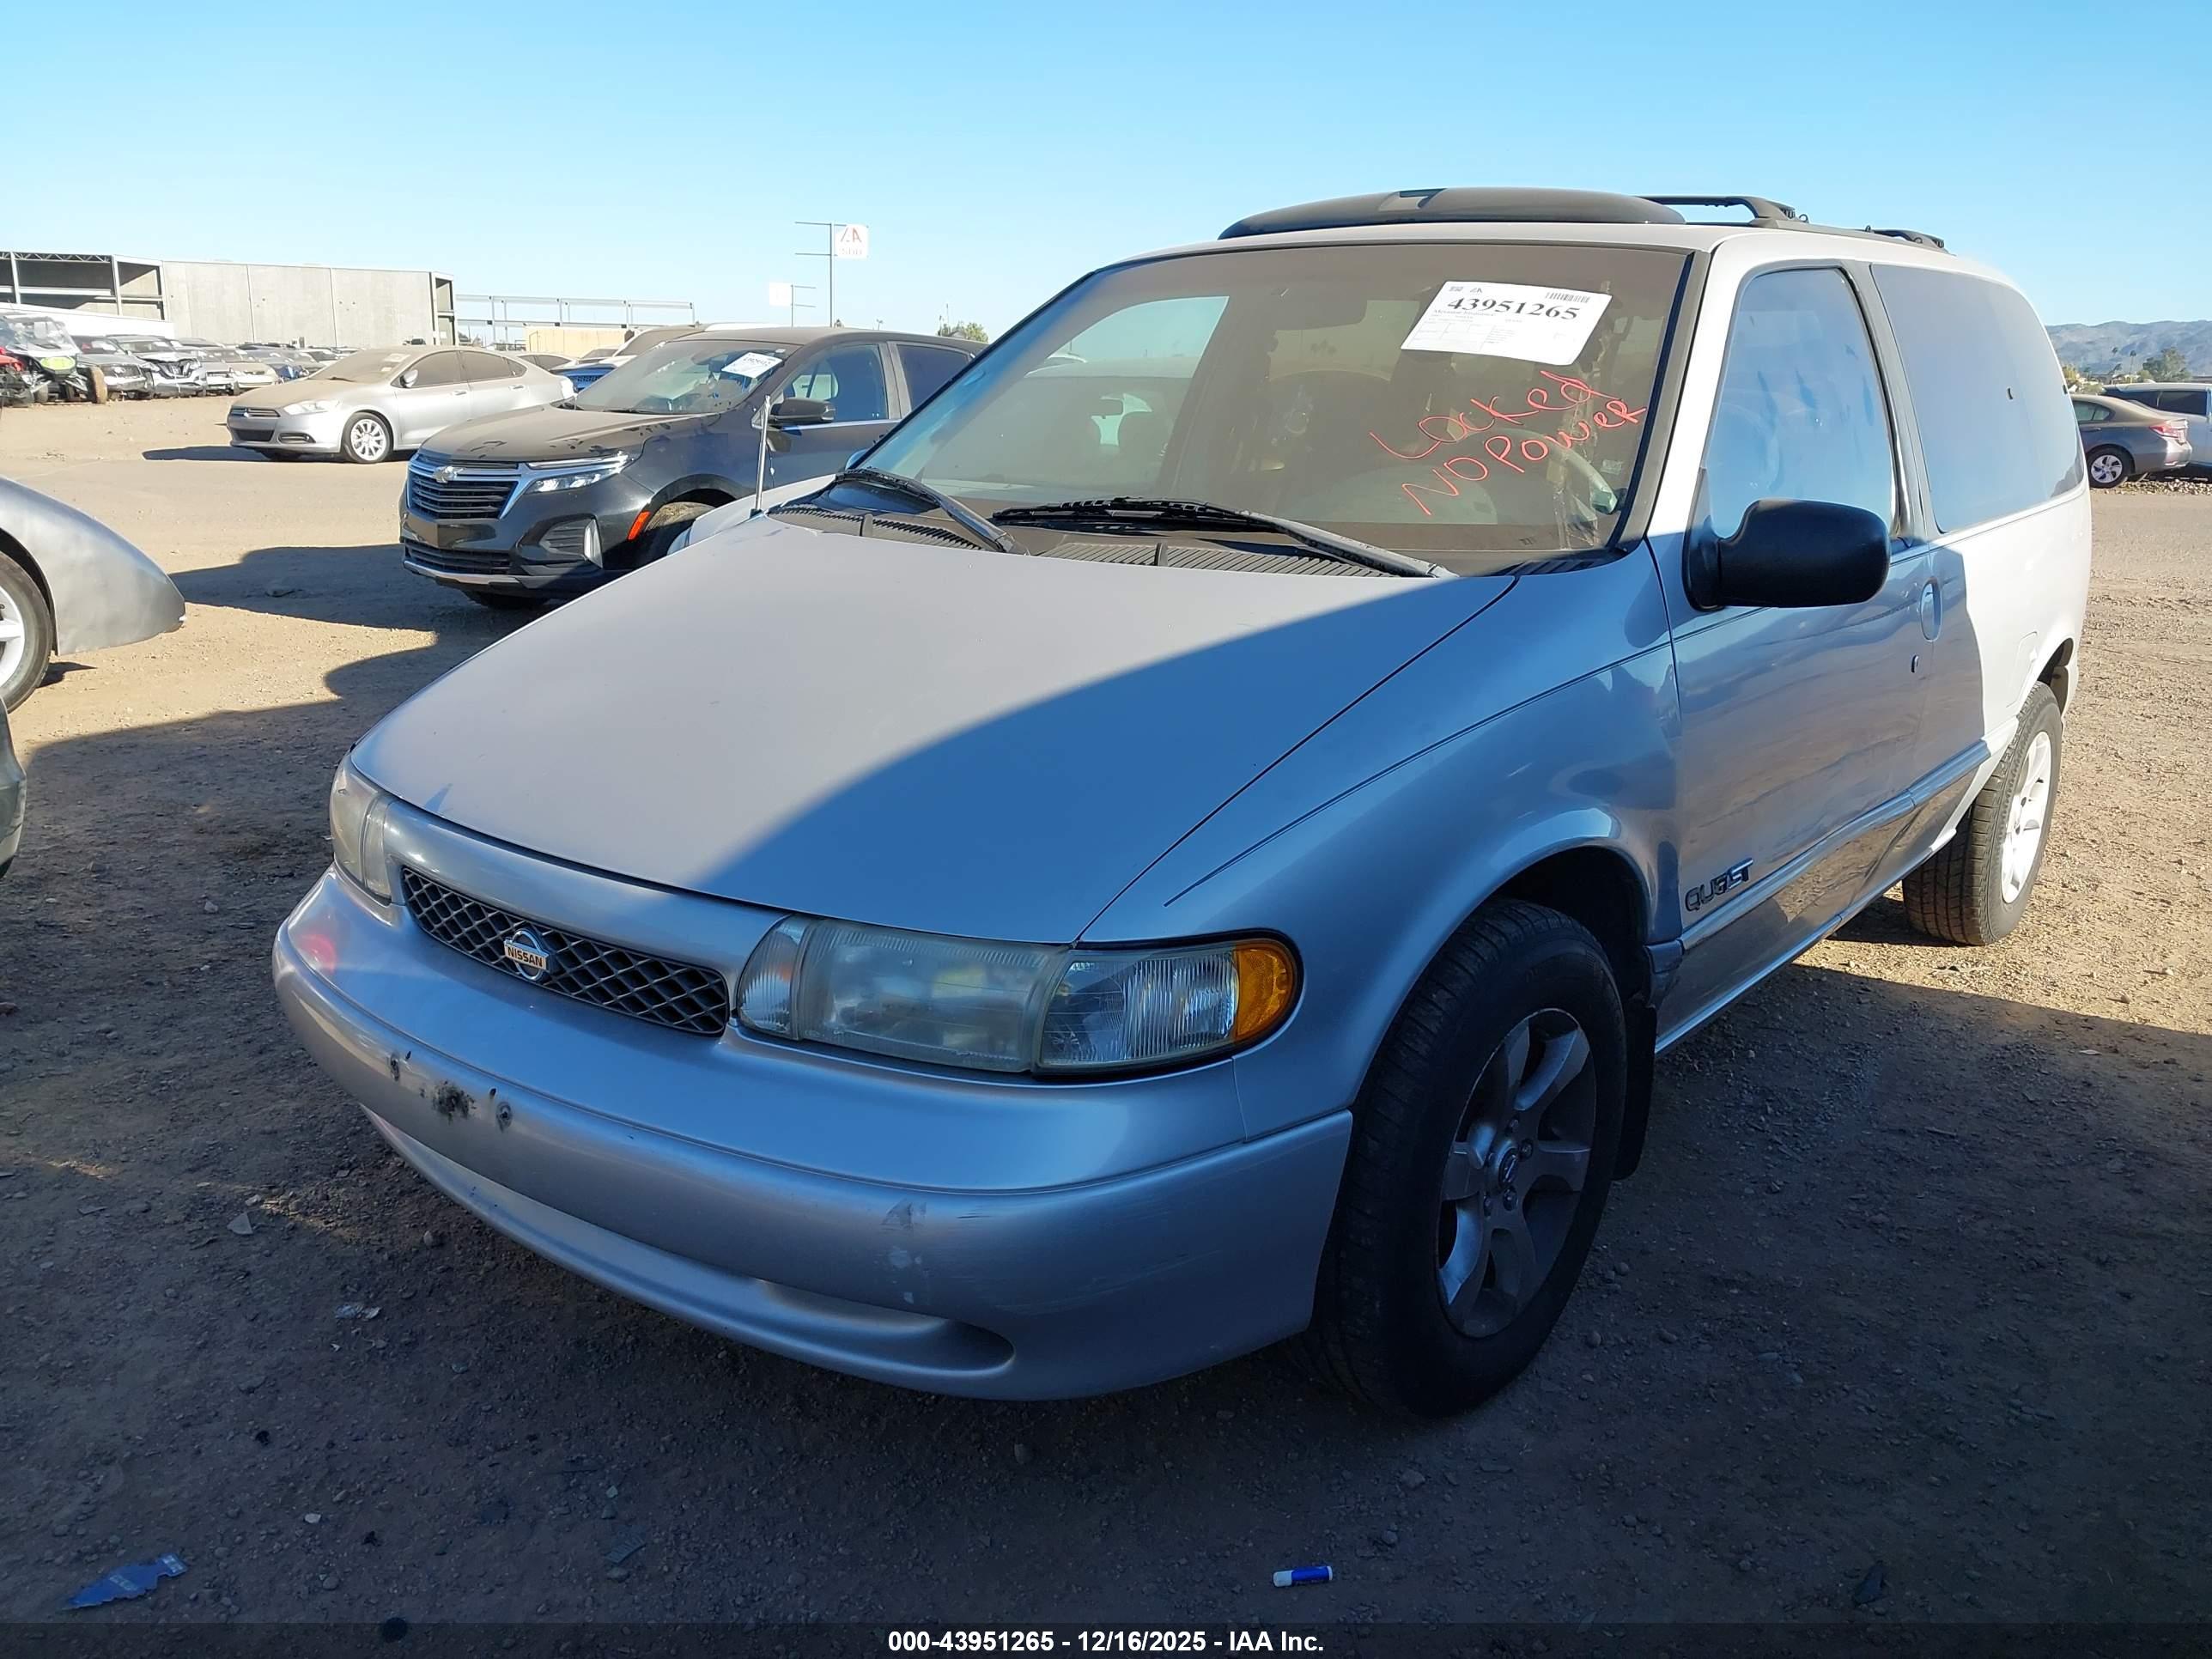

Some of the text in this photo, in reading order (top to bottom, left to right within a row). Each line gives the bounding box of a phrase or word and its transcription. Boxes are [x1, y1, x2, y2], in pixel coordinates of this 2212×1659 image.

[1447, 297, 1581, 319] 43951265
[1685, 857, 1753, 912] QUEST
[507, 946, 544, 968] NISSAN
